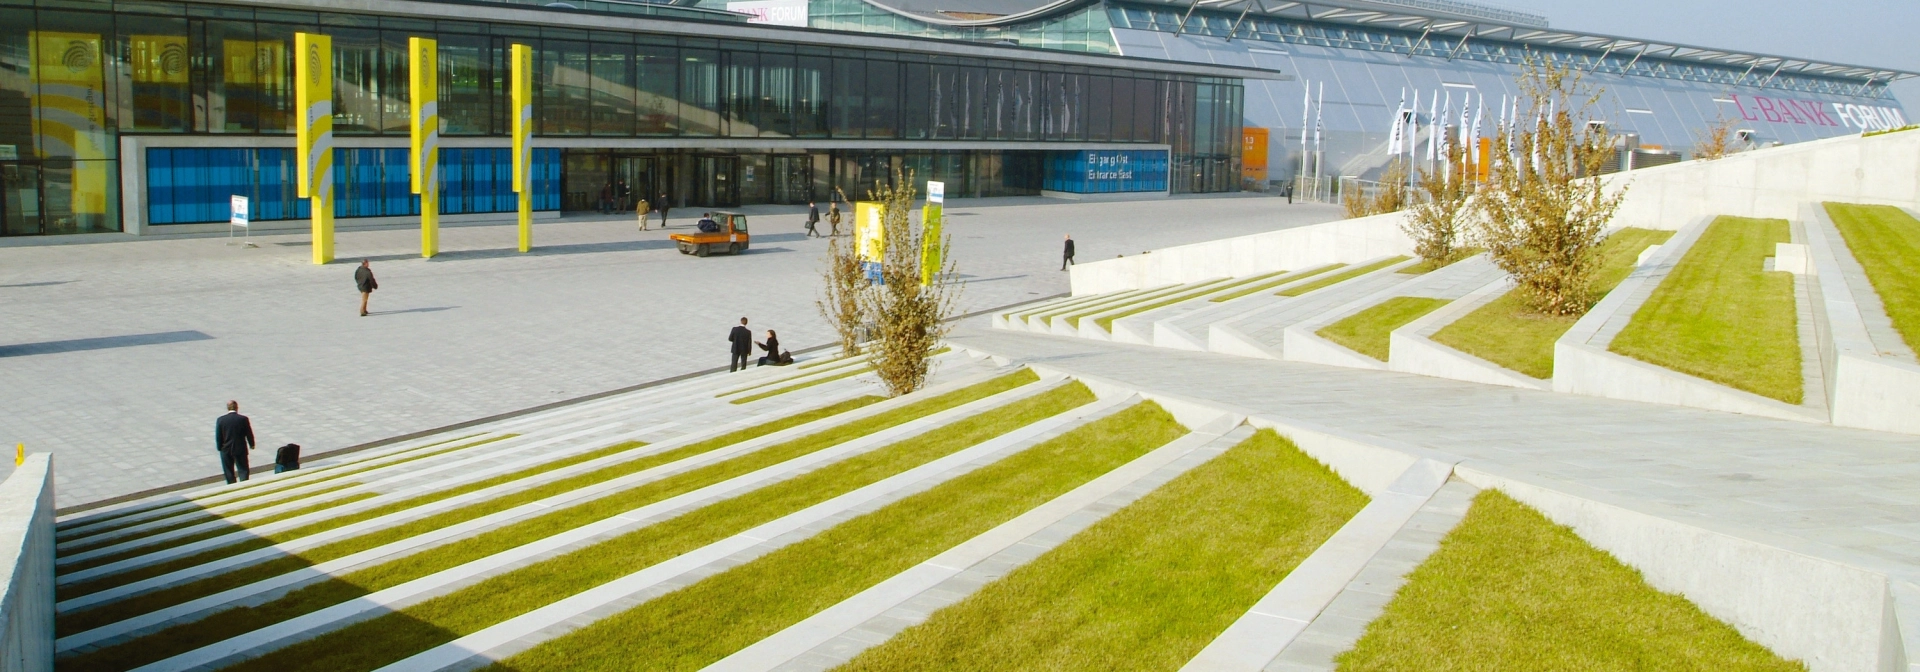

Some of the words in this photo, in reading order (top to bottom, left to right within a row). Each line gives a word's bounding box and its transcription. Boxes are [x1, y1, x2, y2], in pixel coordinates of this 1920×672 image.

[771, 5, 806, 21] FORUM
[1729, 93, 1838, 127] L-BANK
[1832, 102, 1907, 130] FORUM
[1116, 154, 1128, 164] Ost
[1088, 169, 1117, 179] Entrance
[1118, 169, 1132, 179] East
